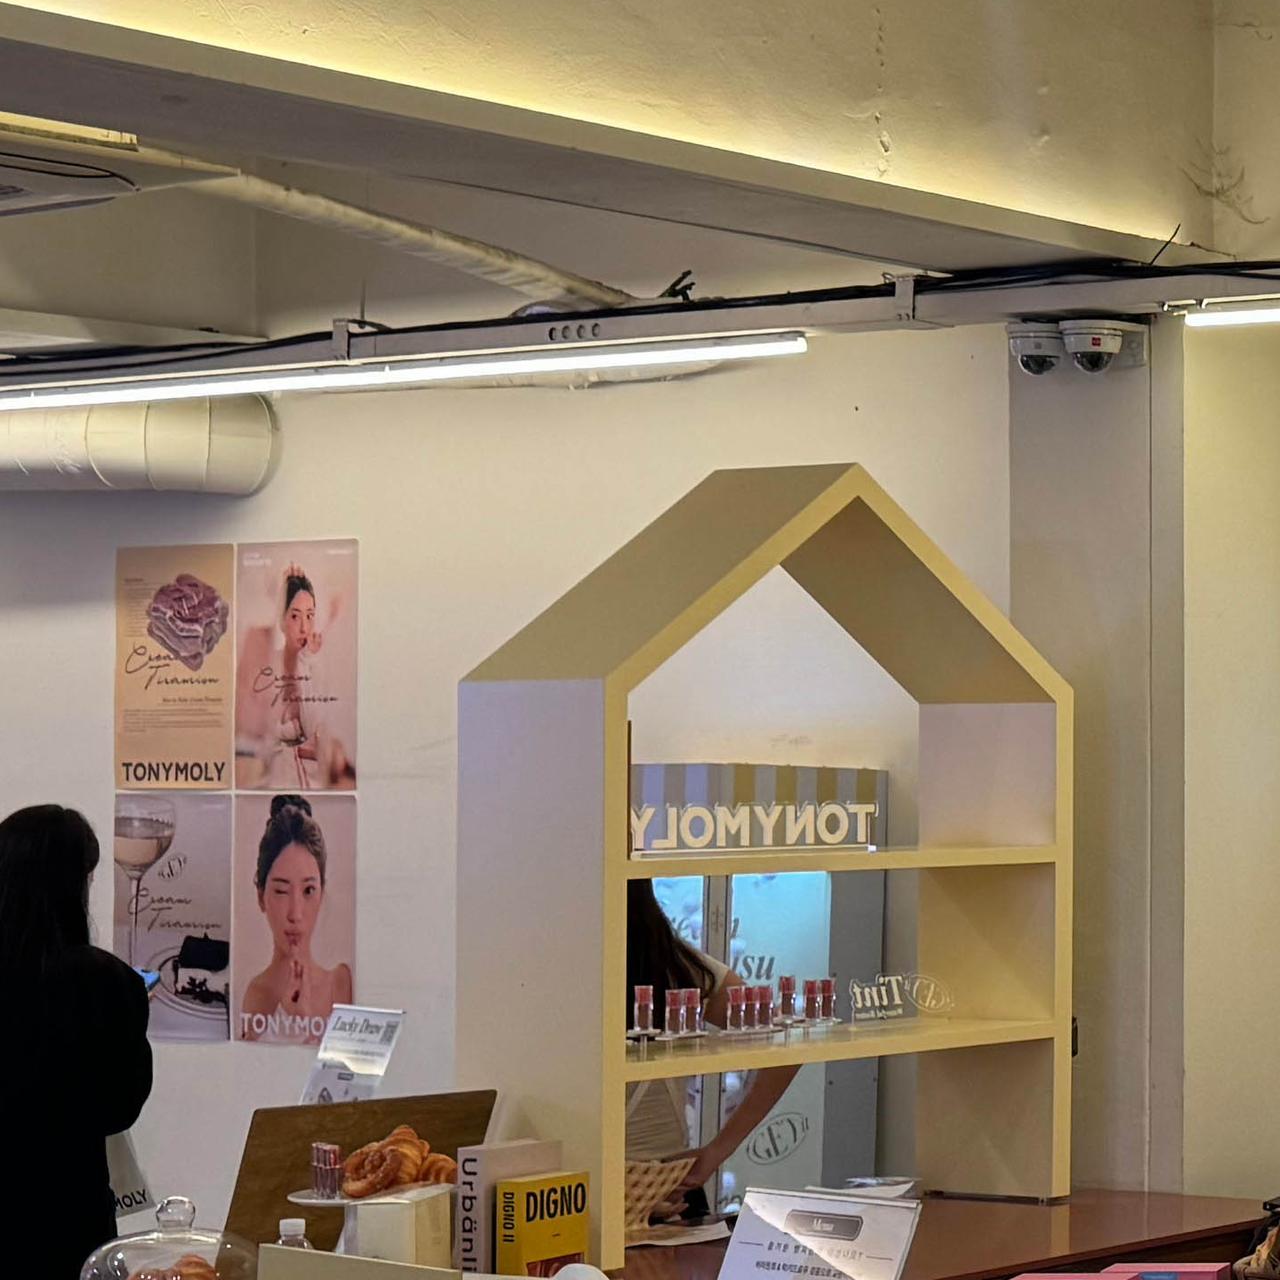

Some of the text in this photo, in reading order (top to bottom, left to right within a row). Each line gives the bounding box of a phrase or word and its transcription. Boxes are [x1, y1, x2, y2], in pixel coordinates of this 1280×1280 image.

[122, 762, 226, 783] TONYMOLY
[240, 1013, 325, 1037] TONYMO
[502, 1191, 515, 1230] DIGNO
[525, 1182, 587, 1223] DIGNO
